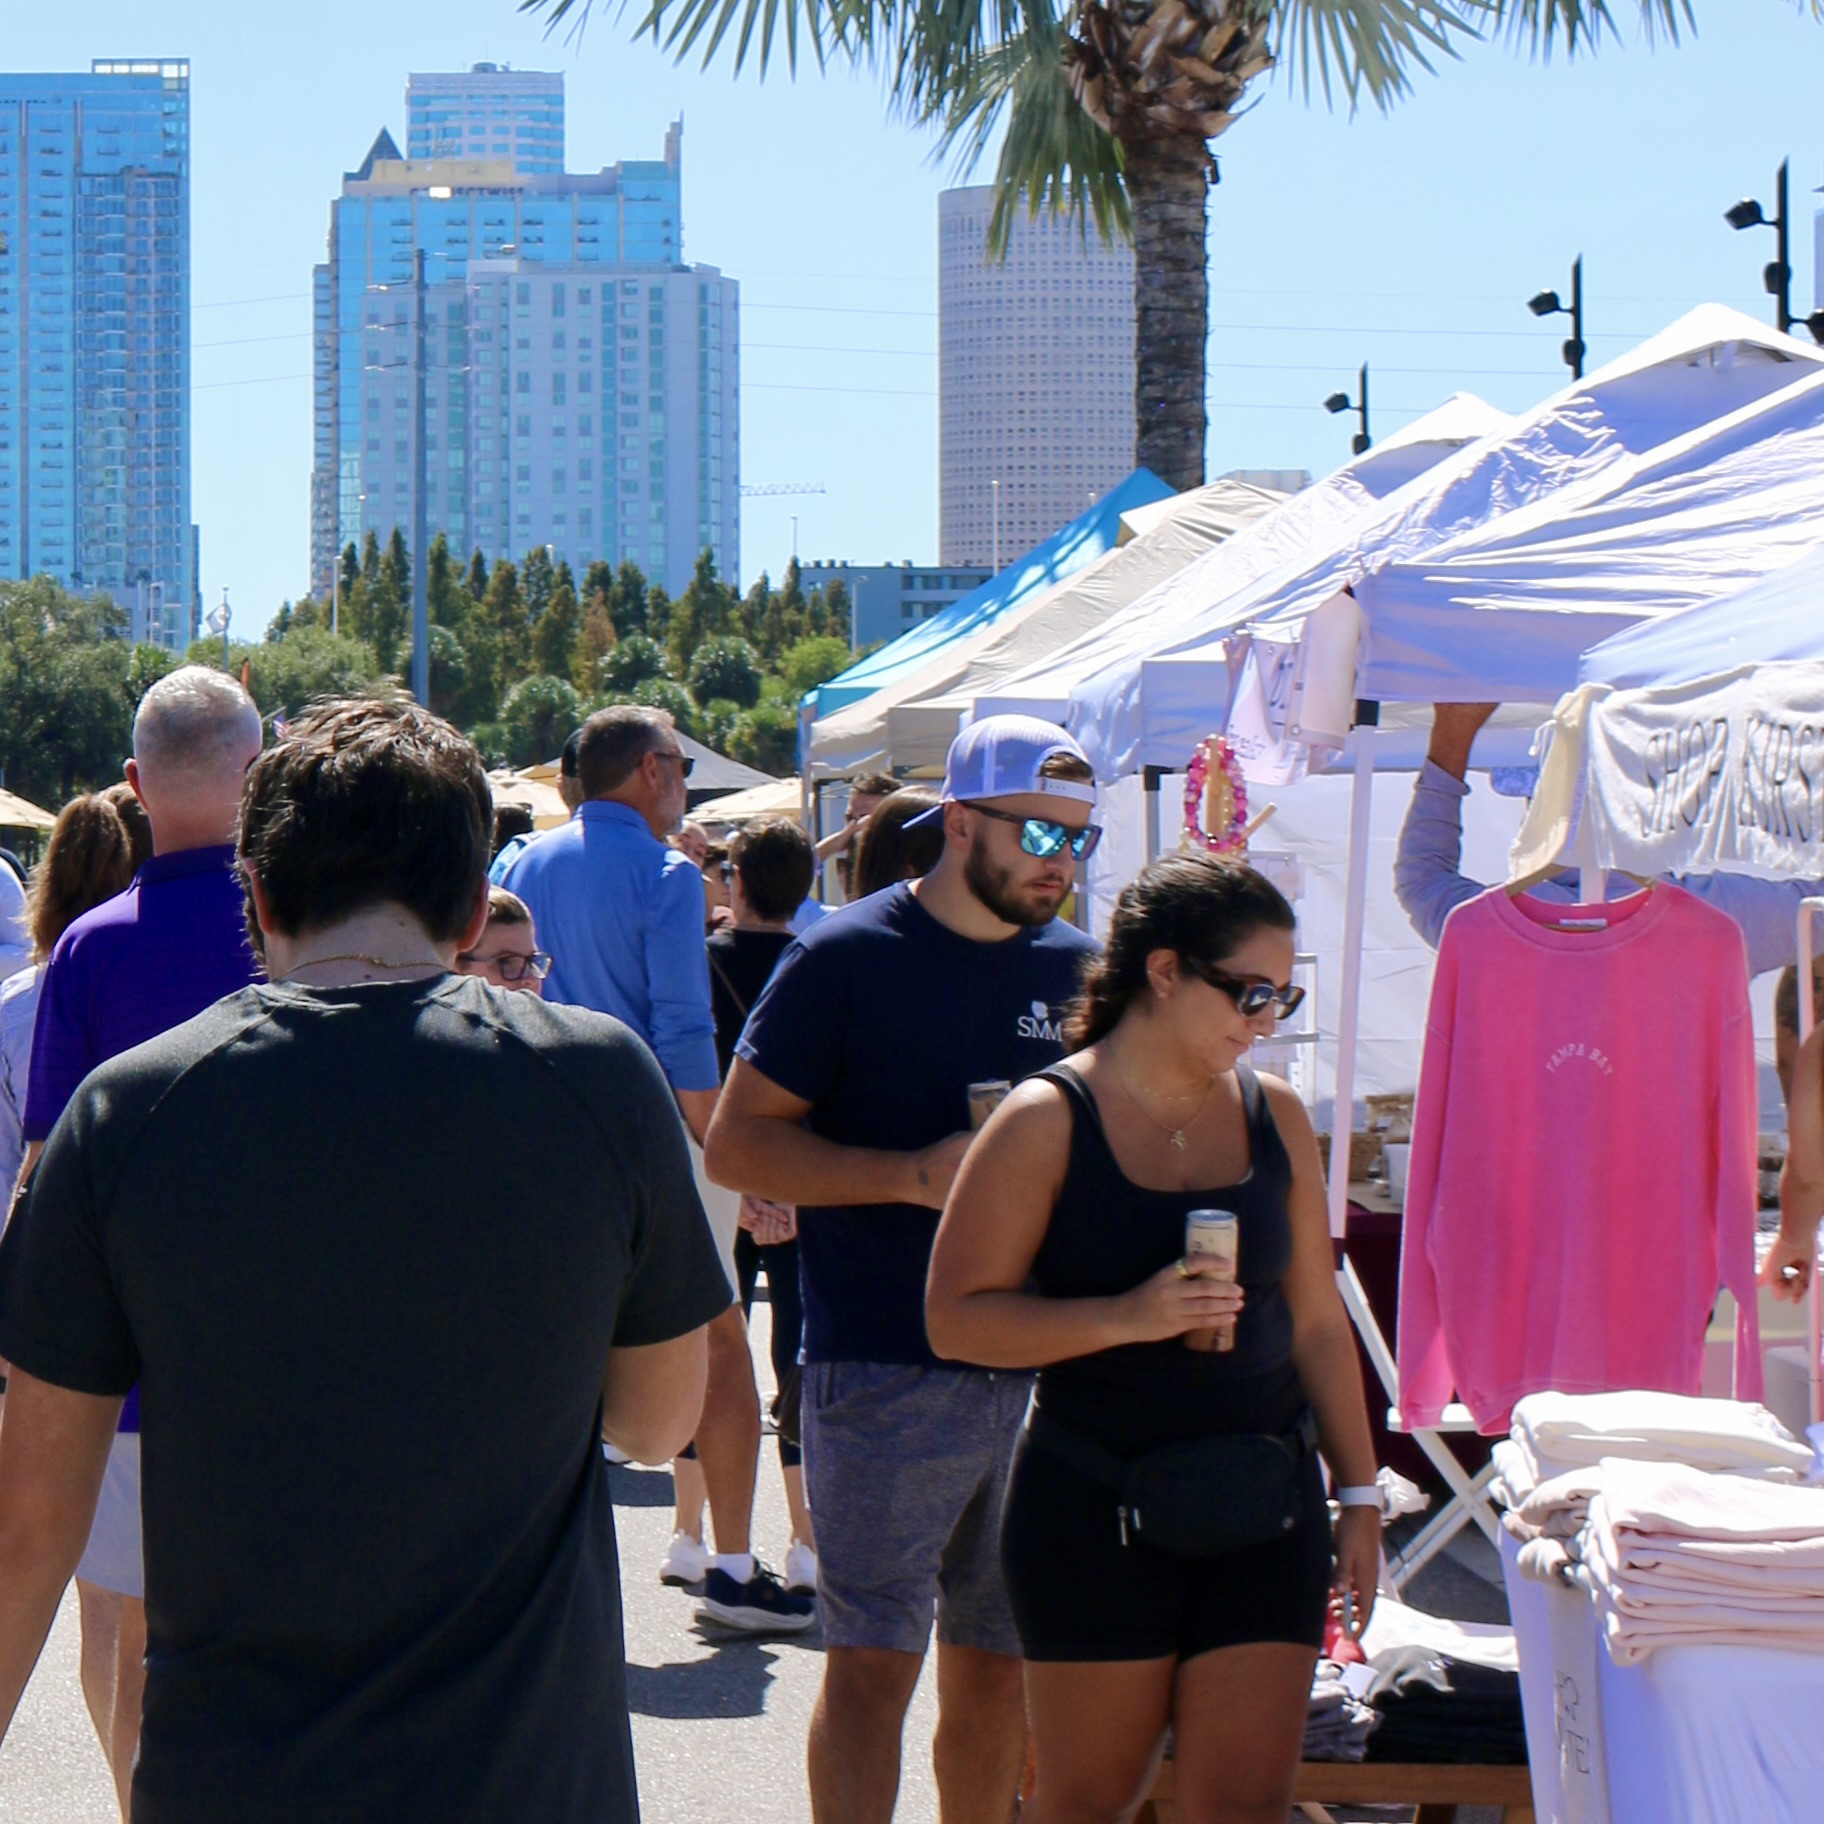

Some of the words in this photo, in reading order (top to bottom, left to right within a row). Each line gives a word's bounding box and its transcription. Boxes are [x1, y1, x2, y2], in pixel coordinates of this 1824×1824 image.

[1738, 717, 1824, 844] KIRS
[1545, 1042, 1585, 1074] TAMPA
[1589, 1047, 1614, 1076] BAY
